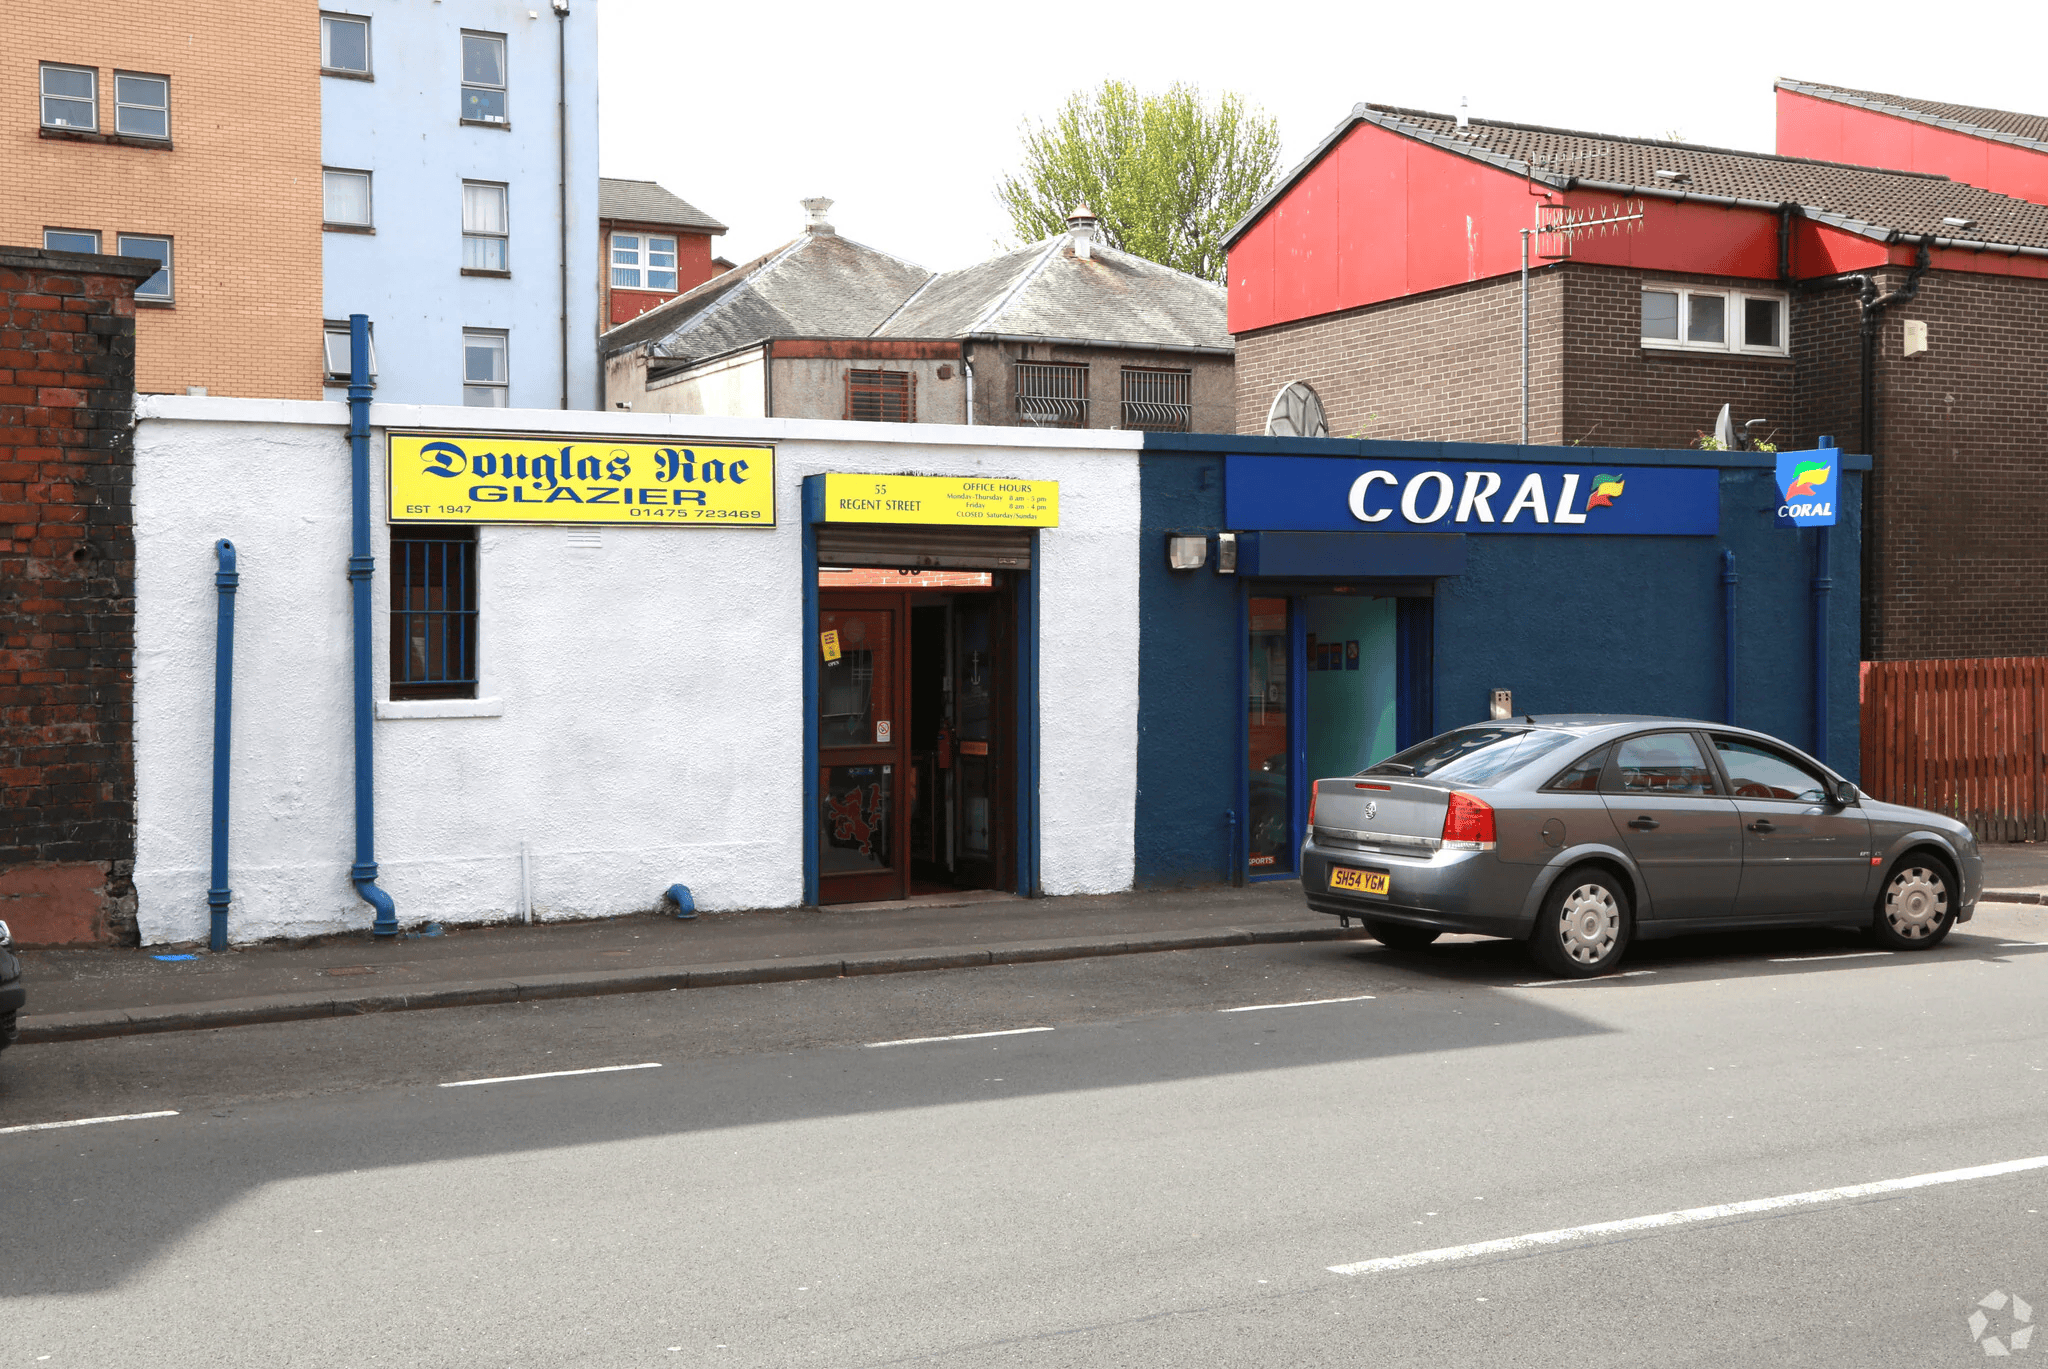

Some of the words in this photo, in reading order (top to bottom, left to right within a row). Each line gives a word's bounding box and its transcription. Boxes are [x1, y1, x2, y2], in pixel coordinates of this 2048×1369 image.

[420, 441, 632, 490] Douglas
[654, 448, 750, 484] Rae
[874, 484, 887, 495] 55
[963, 482, 995, 491] OFFICE
[999, 484, 1032, 492] HOURS
[468, 485, 706, 506] GLAZIER
[947, 493, 1003, 501] Monday-Thursday
[1347, 469, 1588, 524] CORAL
[406, 505, 432, 514] EST
[438, 505, 472, 514] 1947
[840, 498, 881, 510] REGENT
[885, 499, 922, 511] STREET
[1777, 502, 1832, 518] CORAL
[629, 508, 688, 518] 01475
[694, 509, 761, 519] 723469
[986, 512, 1037, 520] Saturday/Sunday
[1335, 870, 1362, 887] SH54
[1364, 873, 1385, 890] YGM
